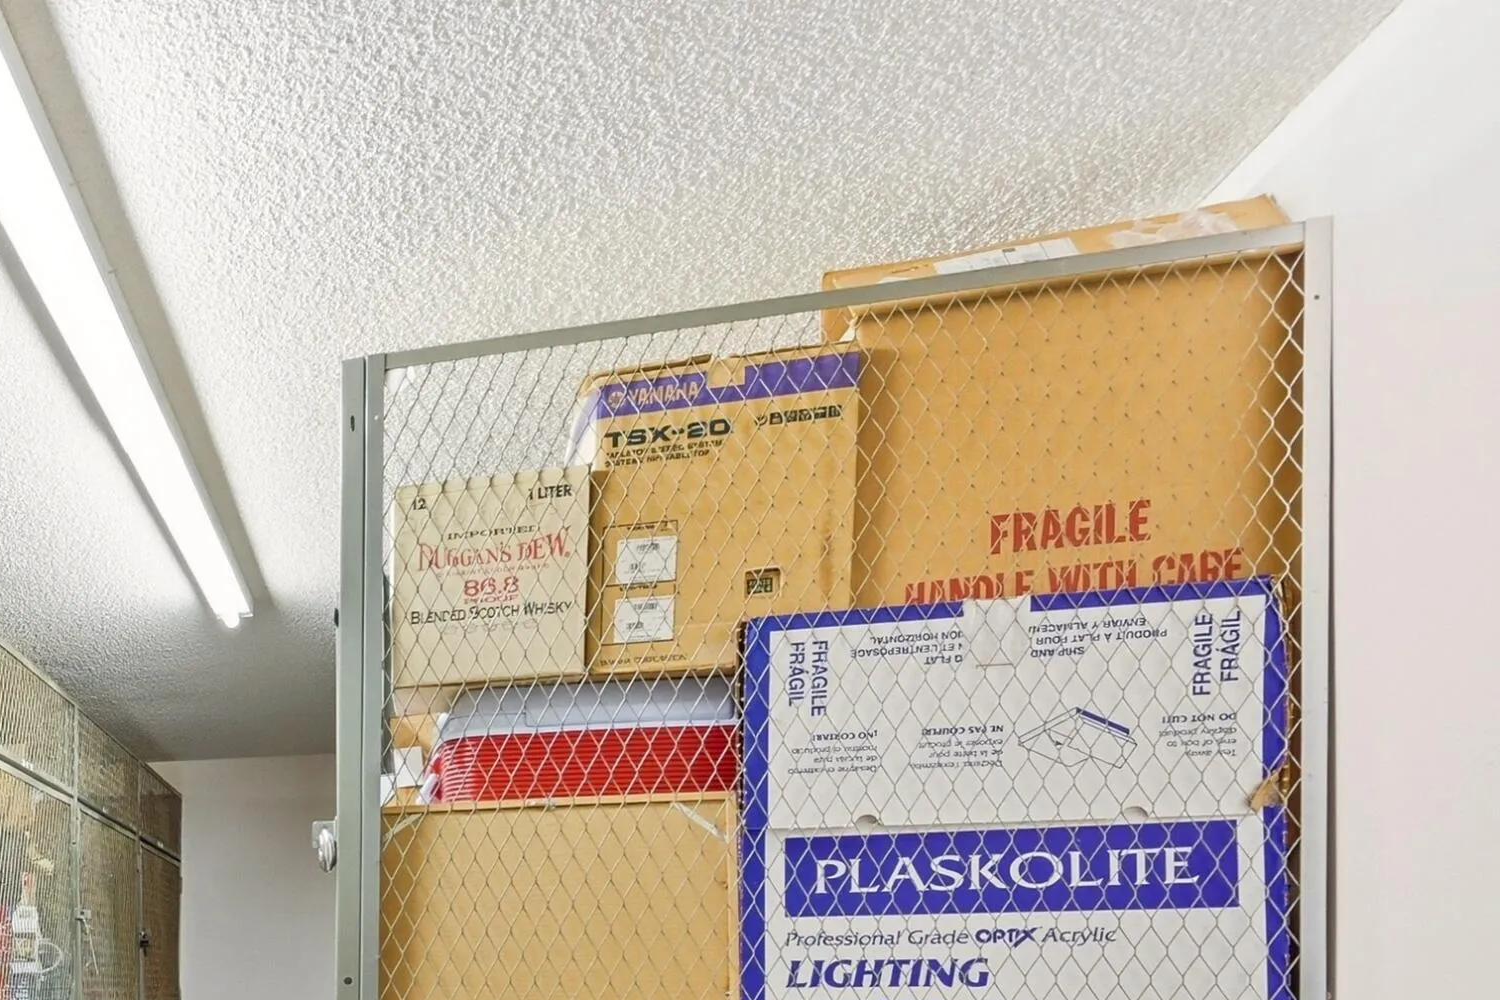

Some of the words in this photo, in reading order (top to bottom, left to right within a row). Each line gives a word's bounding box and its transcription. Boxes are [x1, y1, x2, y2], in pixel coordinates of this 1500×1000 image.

[604, 418, 732, 448] TSX-20
[411, 497, 427, 511] 12
[537, 484, 573, 500] LITER
[989, 498, 1152, 556] FRAGILE
[1047, 558, 1137, 593] WITH
[1151, 547, 1245, 585] CARE
[410, 609, 467, 625] BLENDED
[1192, 613, 1213, 696] FRAGILE
[810, 639, 829, 717] FRAGILE
[1190, 714, 1215, 722] NOT
[813, 845, 1200, 895] PLASKOLITE
[784, 931, 900, 948] Professional
[907, 929, 969, 945] Grade
[1041, 927, 1117, 946] Acrylic
[784, 957, 990, 989] LIGHTING
